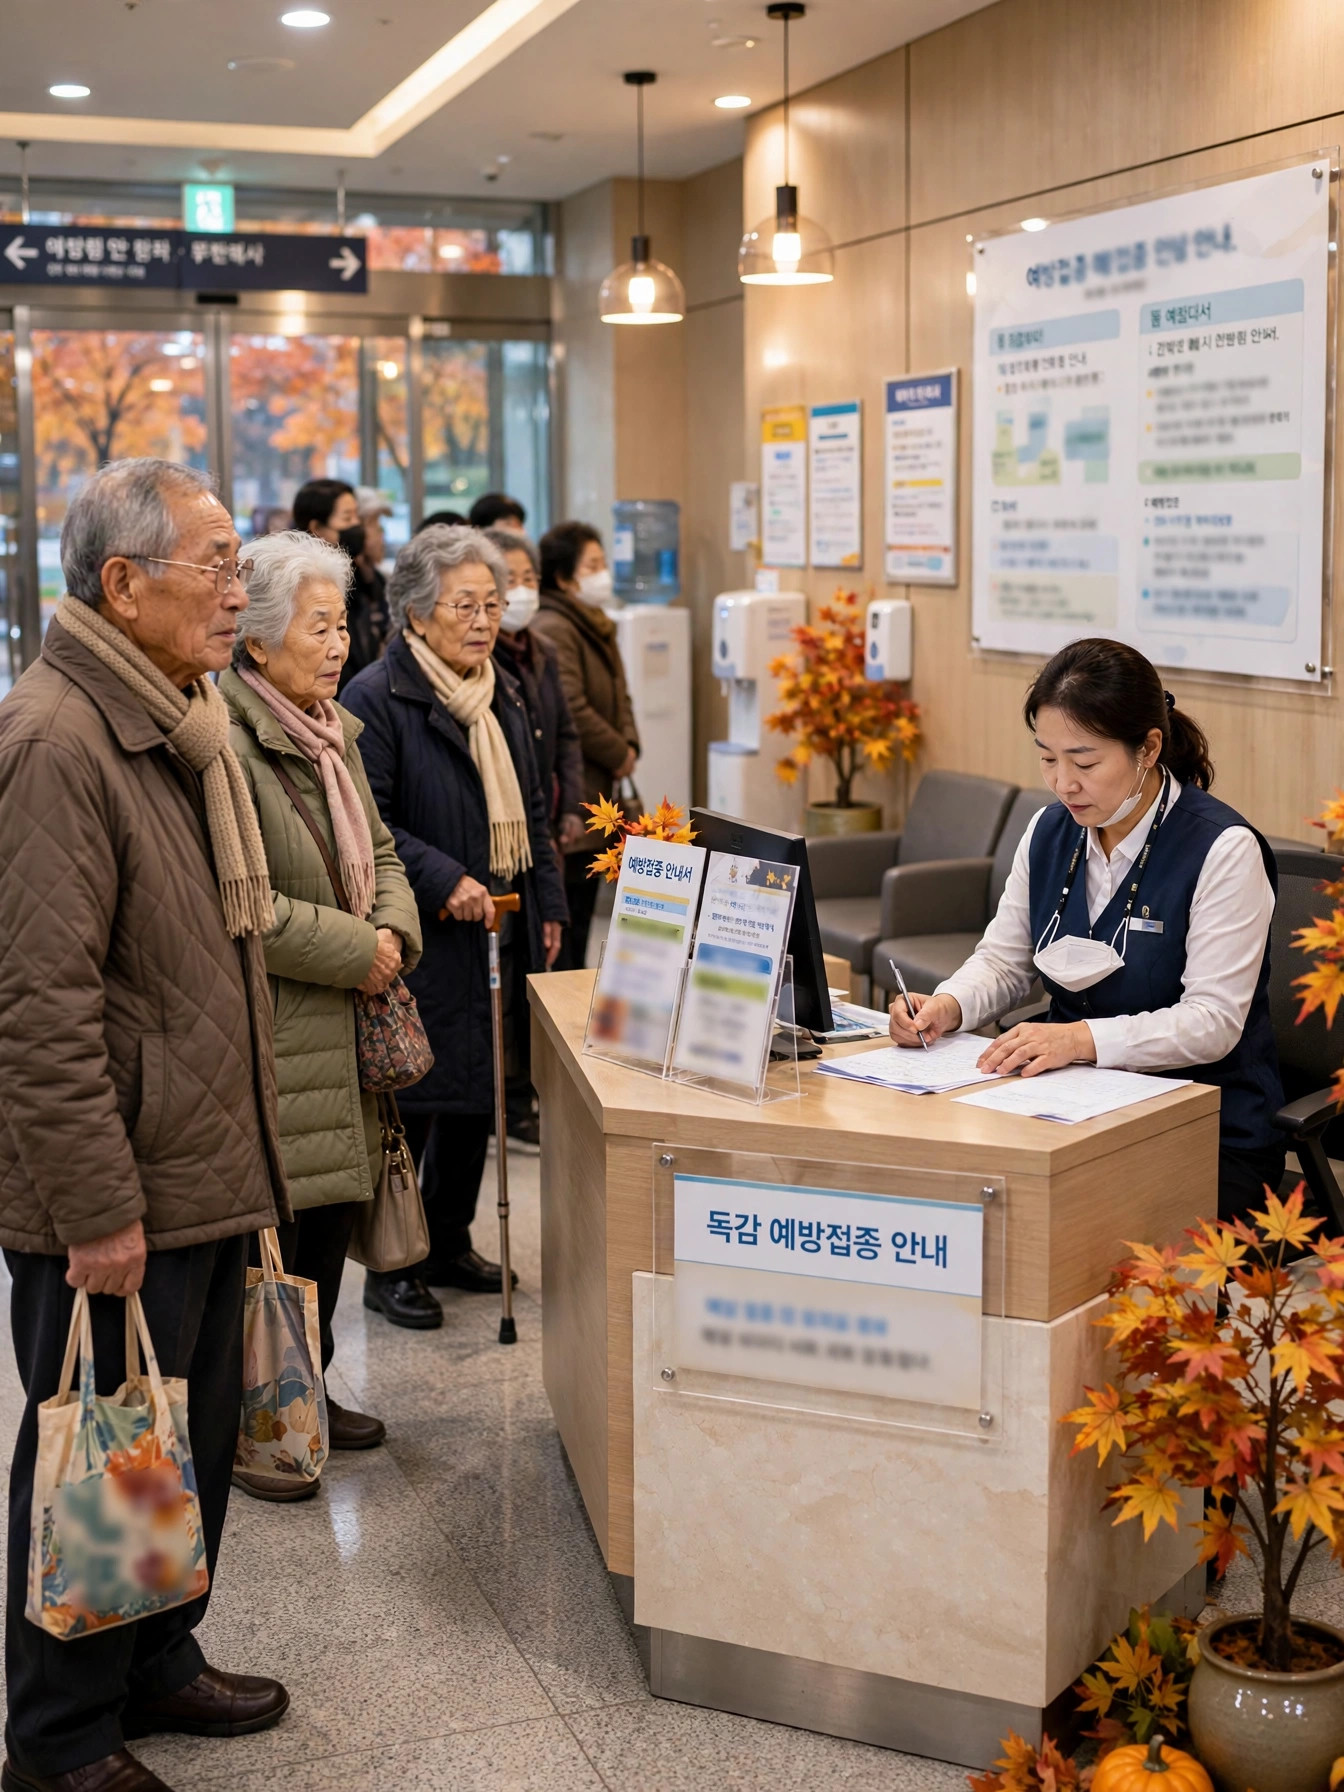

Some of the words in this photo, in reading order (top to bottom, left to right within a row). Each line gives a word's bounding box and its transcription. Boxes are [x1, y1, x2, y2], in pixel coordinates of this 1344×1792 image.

[665, 862, 693, 883] 안내서
[706, 1209, 762, 1246] 독감
[769, 1217, 882, 1261] 예방접종
[891, 1231, 948, 1269] 안내
